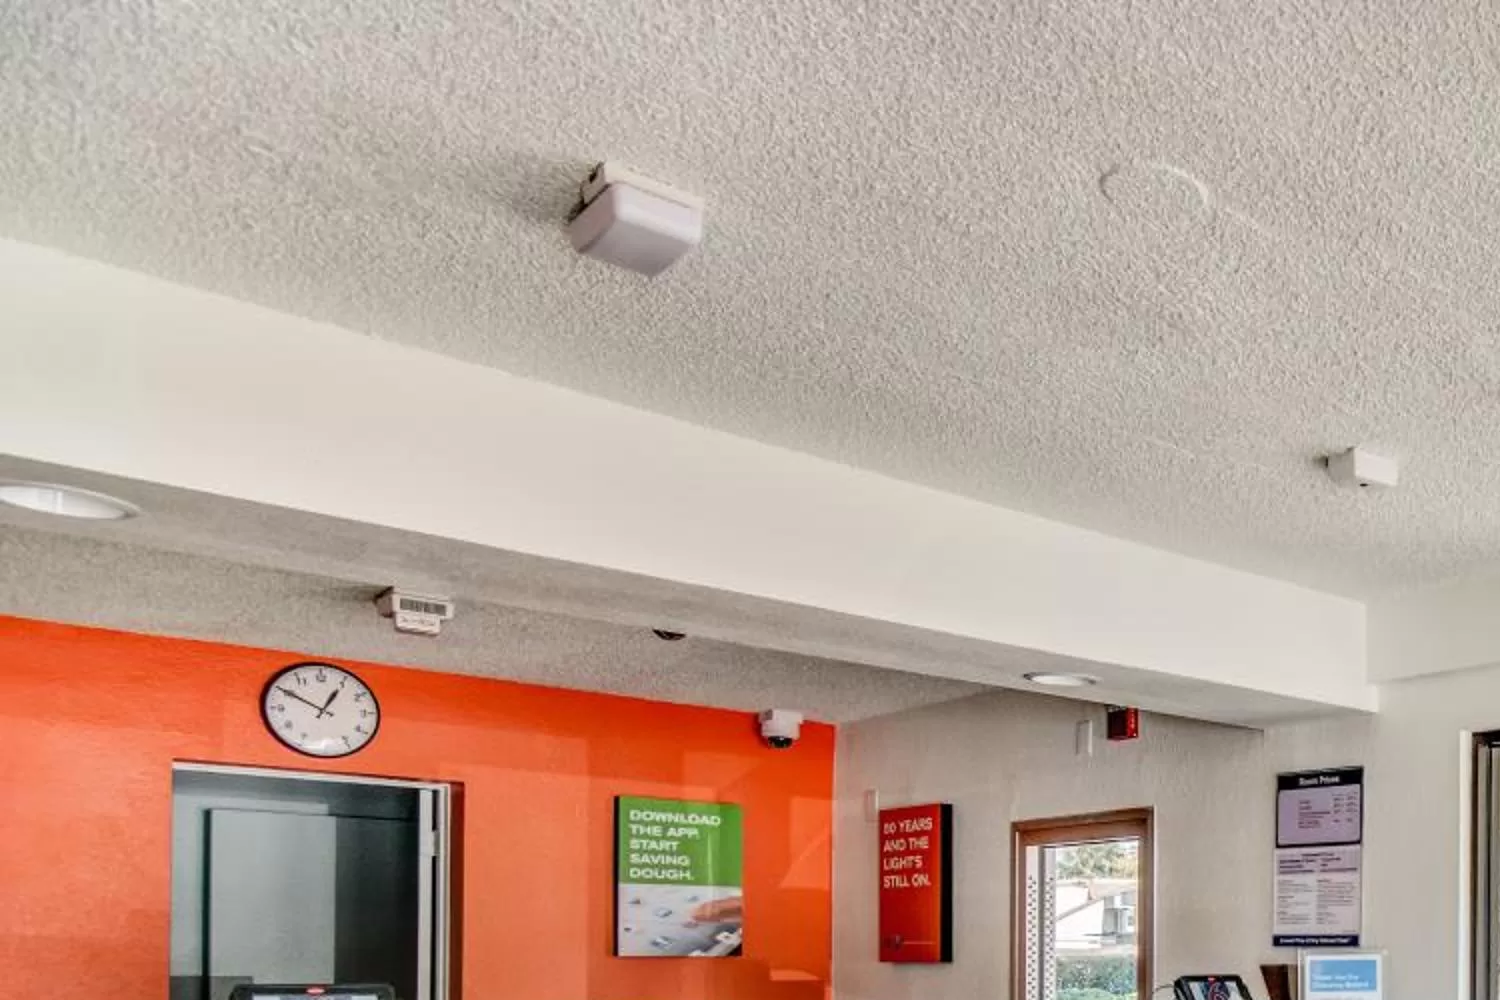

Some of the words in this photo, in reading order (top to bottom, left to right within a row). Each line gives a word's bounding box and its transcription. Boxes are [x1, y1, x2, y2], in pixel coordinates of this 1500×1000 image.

[629, 809, 721, 827] DOWNLOAD
[898, 817, 933, 833] YEARS
[629, 823, 664, 837] THE
[629, 838, 680, 851] START
[883, 838, 907, 852] AND
[908, 836, 929, 850] THE
[629, 852, 691, 867] SAVING
[629, 867, 695, 881] DOUGH.
[883, 873, 910, 889] STILL
